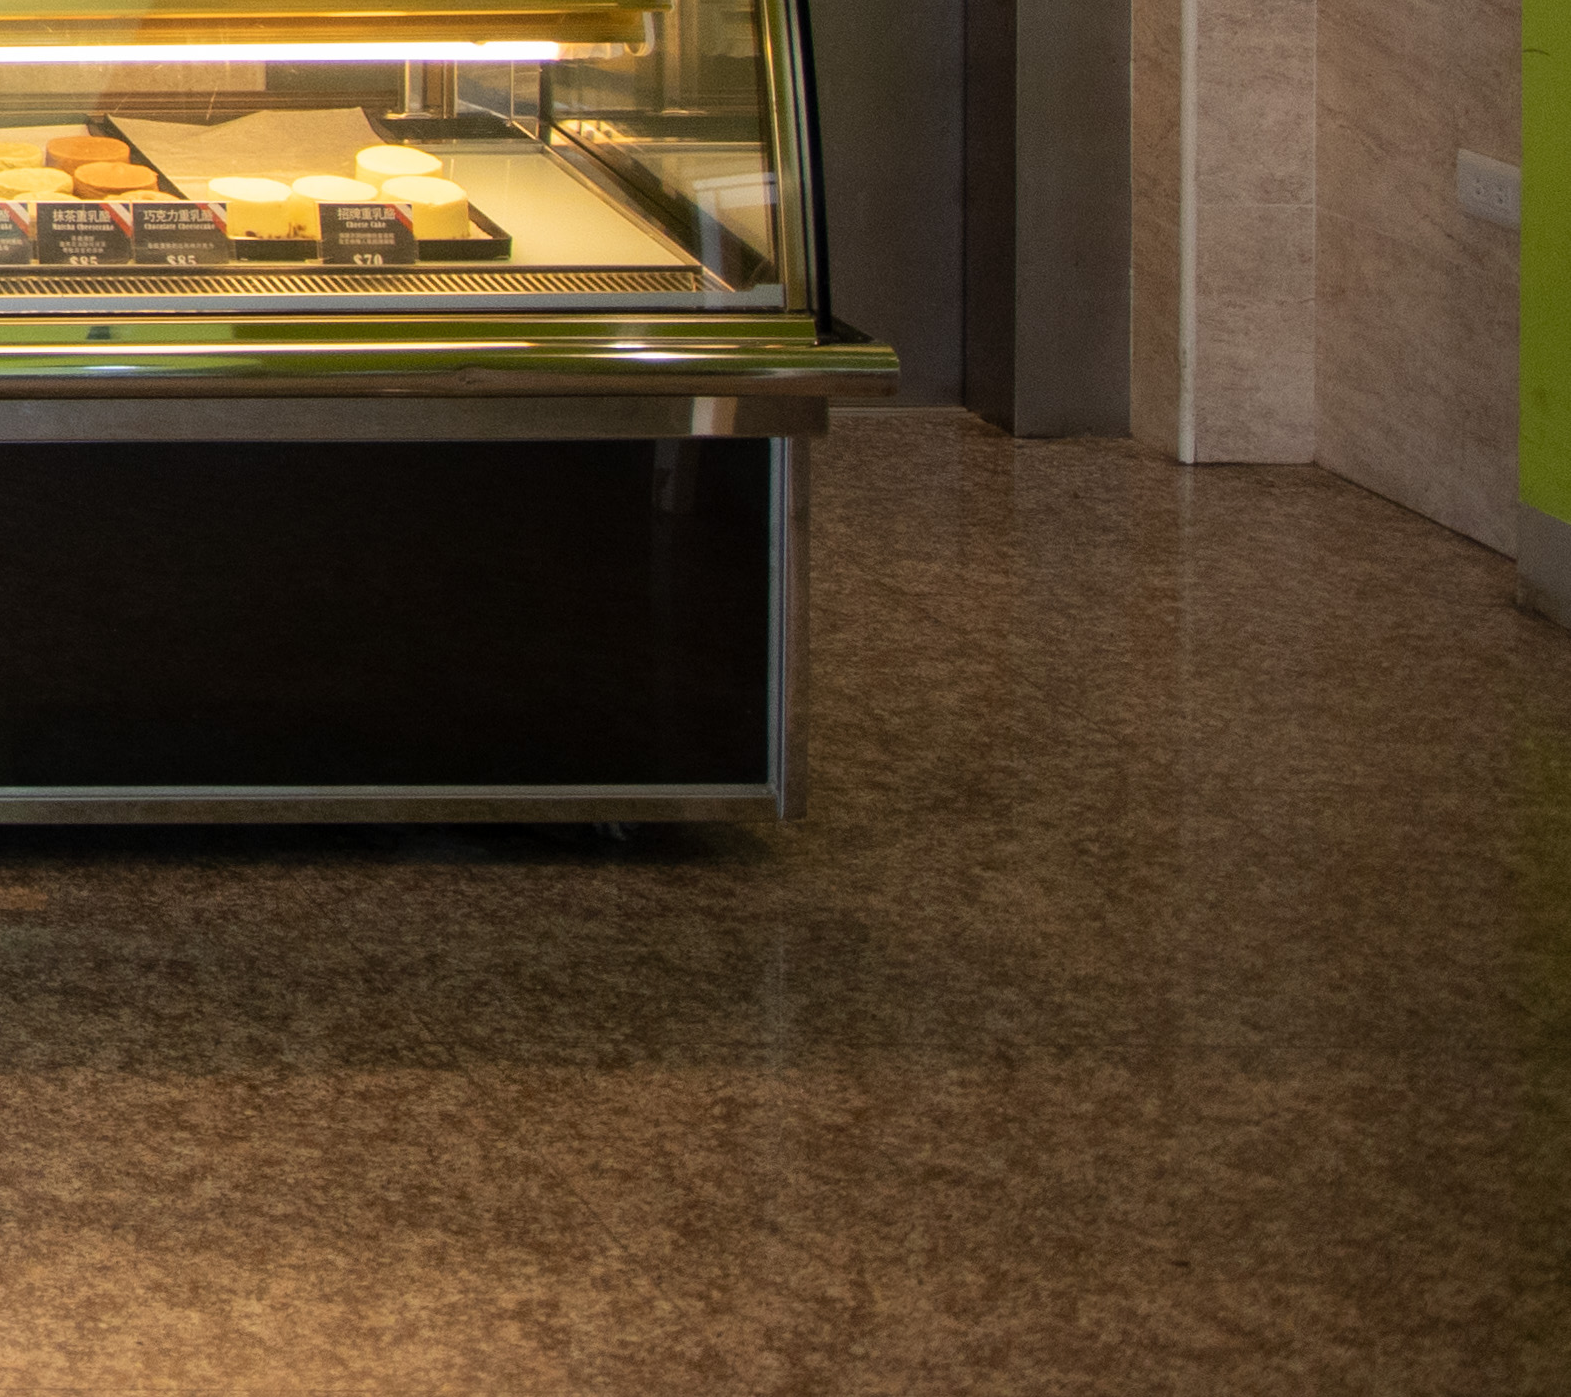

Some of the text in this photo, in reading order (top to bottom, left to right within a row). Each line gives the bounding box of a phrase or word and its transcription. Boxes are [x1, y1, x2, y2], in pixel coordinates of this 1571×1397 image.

[52, 209, 112, 223] 抹茶重乳酪
[142, 209, 214, 223] 巧克力重乳酪
[337, 207, 396, 221] 招牌重乳酪
